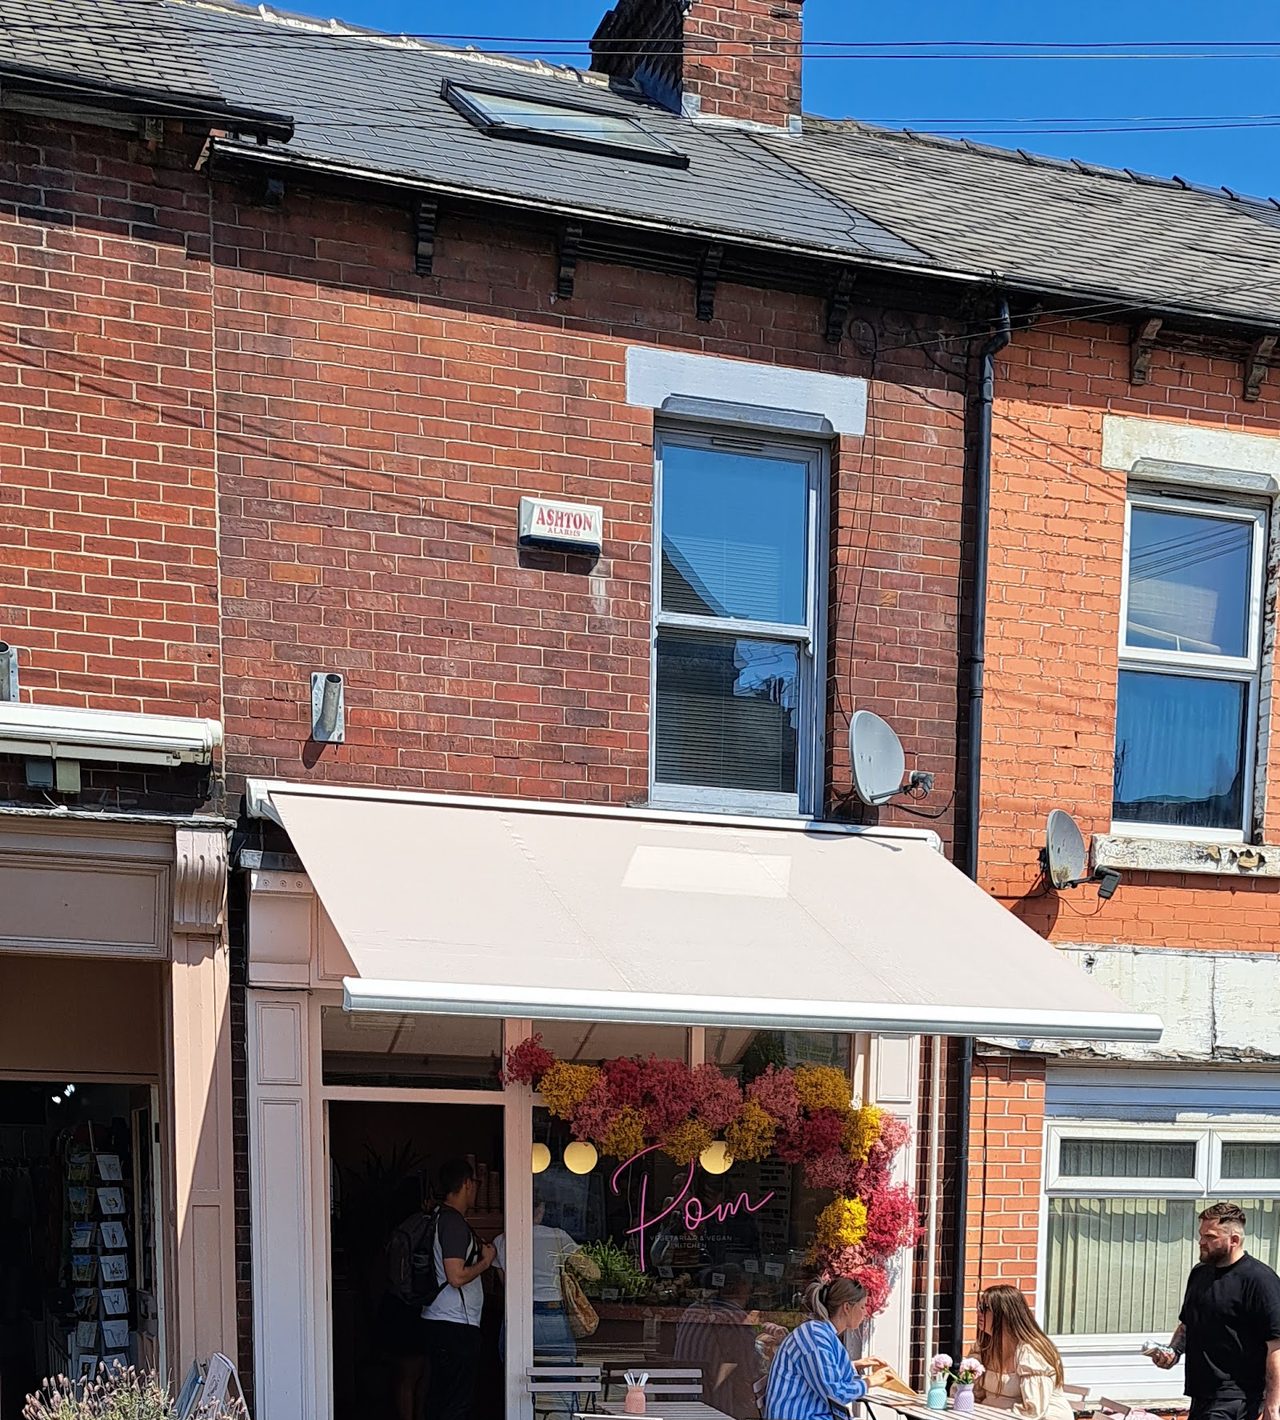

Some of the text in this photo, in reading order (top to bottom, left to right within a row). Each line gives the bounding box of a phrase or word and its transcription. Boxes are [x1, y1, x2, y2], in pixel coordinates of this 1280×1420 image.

[536, 506, 593, 531] ASHTON
[547, 527, 581, 537] ALARMS
[611, 1142, 775, 1273] Pom
